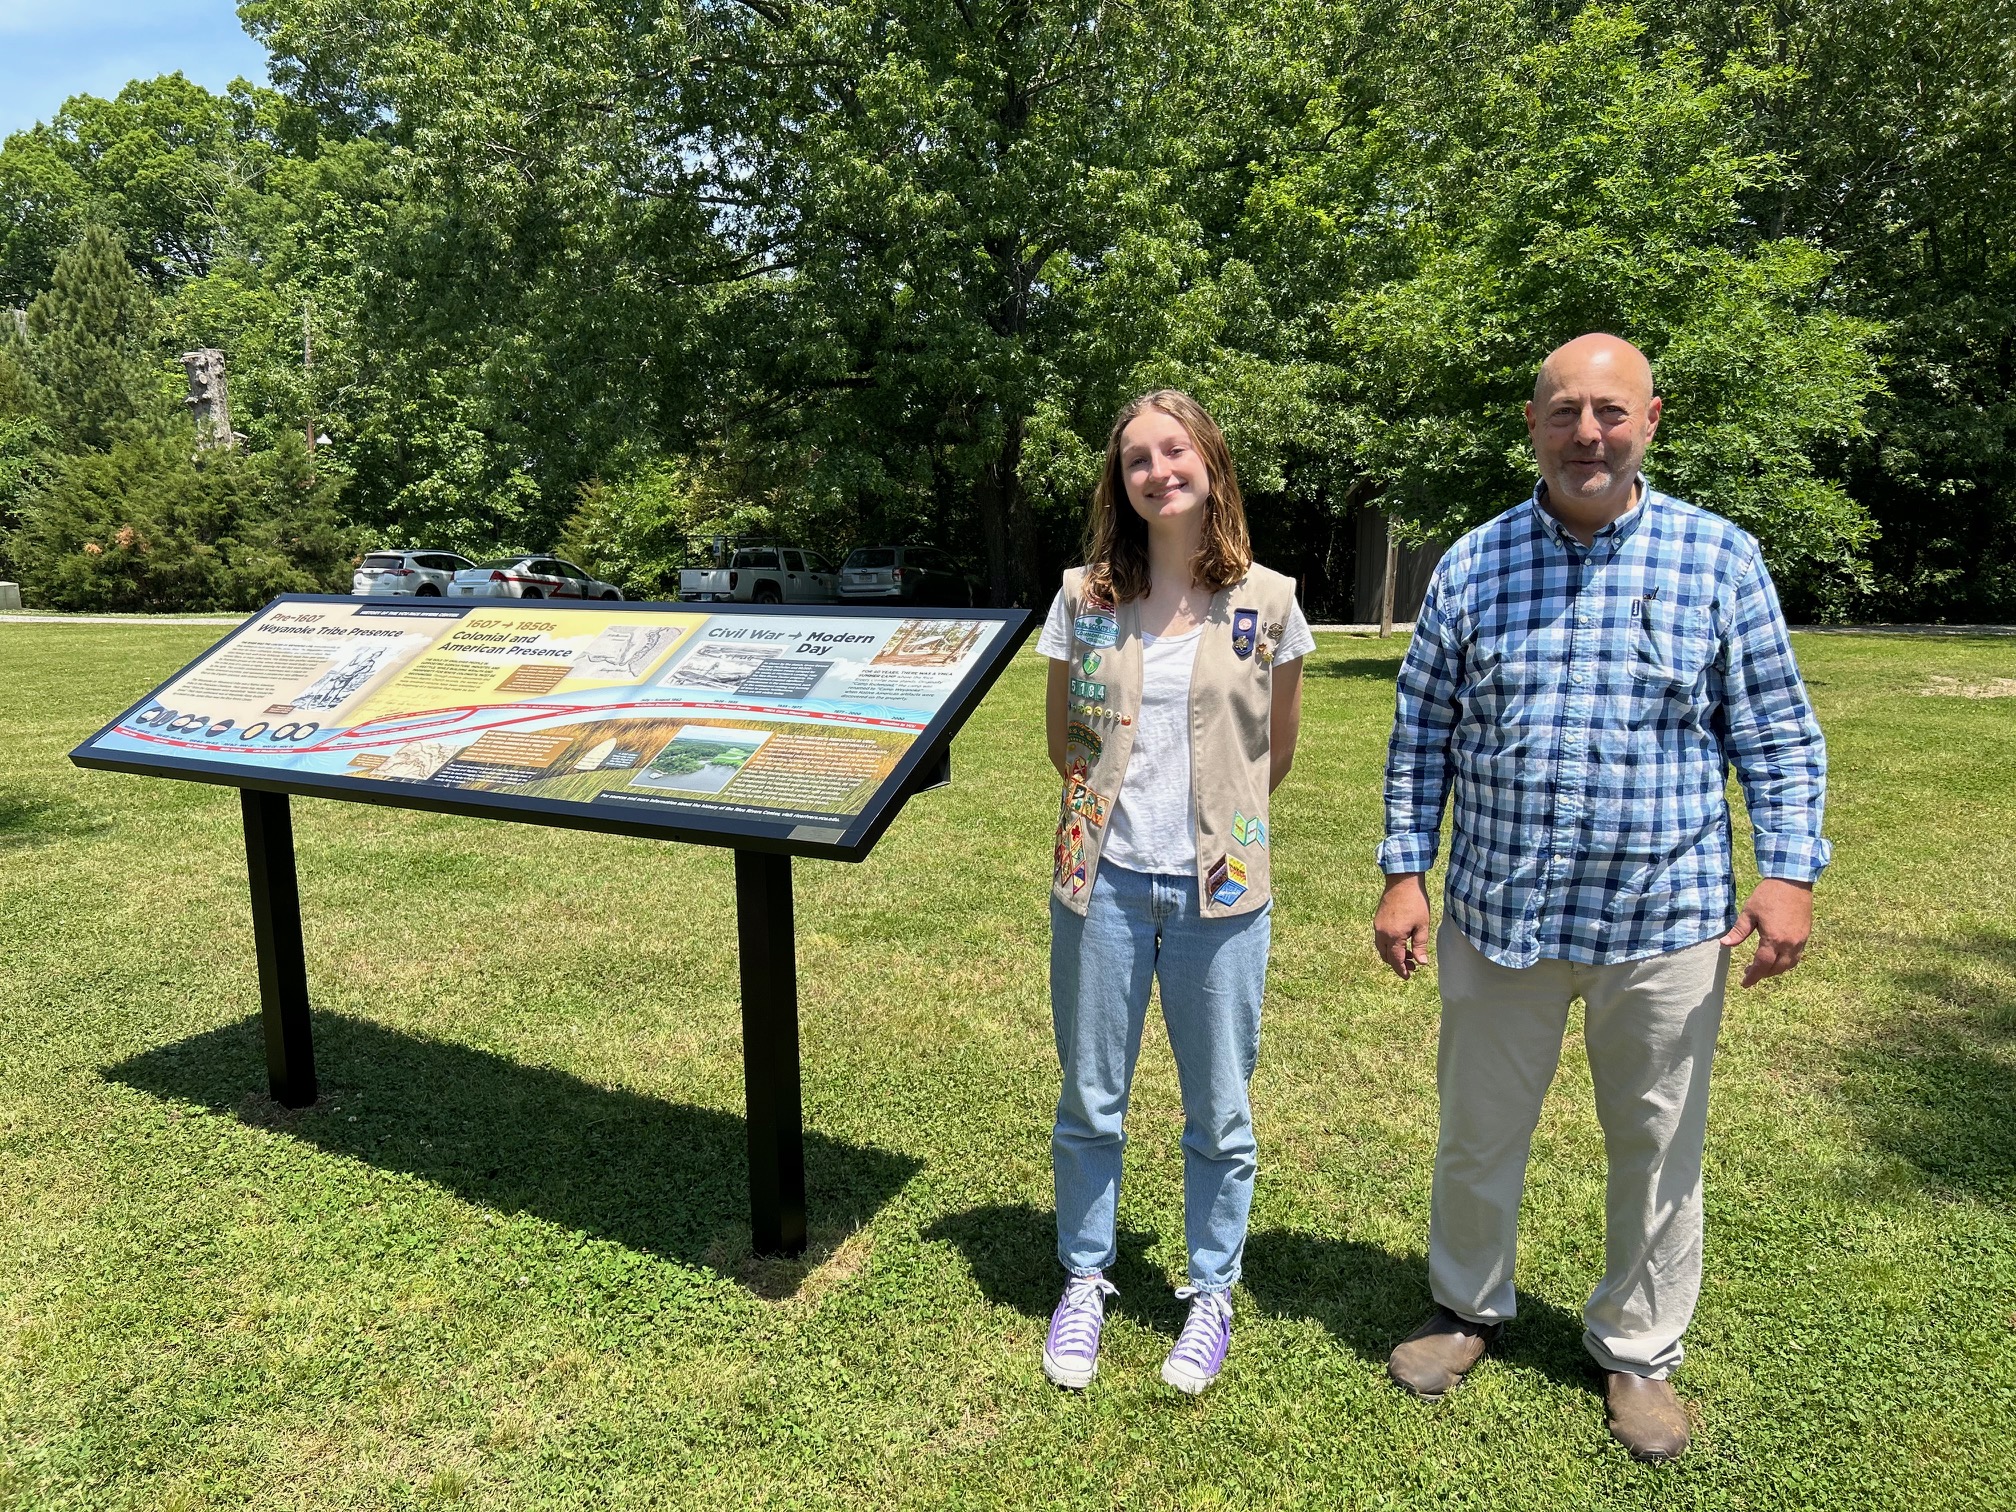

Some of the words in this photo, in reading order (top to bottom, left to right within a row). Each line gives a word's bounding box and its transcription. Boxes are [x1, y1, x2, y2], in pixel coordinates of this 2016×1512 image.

[270, 614, 325, 622] Pre-1607
[258, 624, 316, 634] Weyanoke
[317, 626, 348, 635] Tribe
[348, 628, 404, 637] Presence
[466, 620, 501, 628] 1607
[516, 622, 557, 631] 1850s
[452, 632, 511, 642] Colonial
[509, 635, 541, 644] and
[708, 628, 748, 638] Civil
[749, 629, 785, 640] War
[806, 632, 876, 644] Modern
[437, 642, 506, 654] American
[506, 646, 573, 657] Presence
[796, 644, 833, 655] Day
